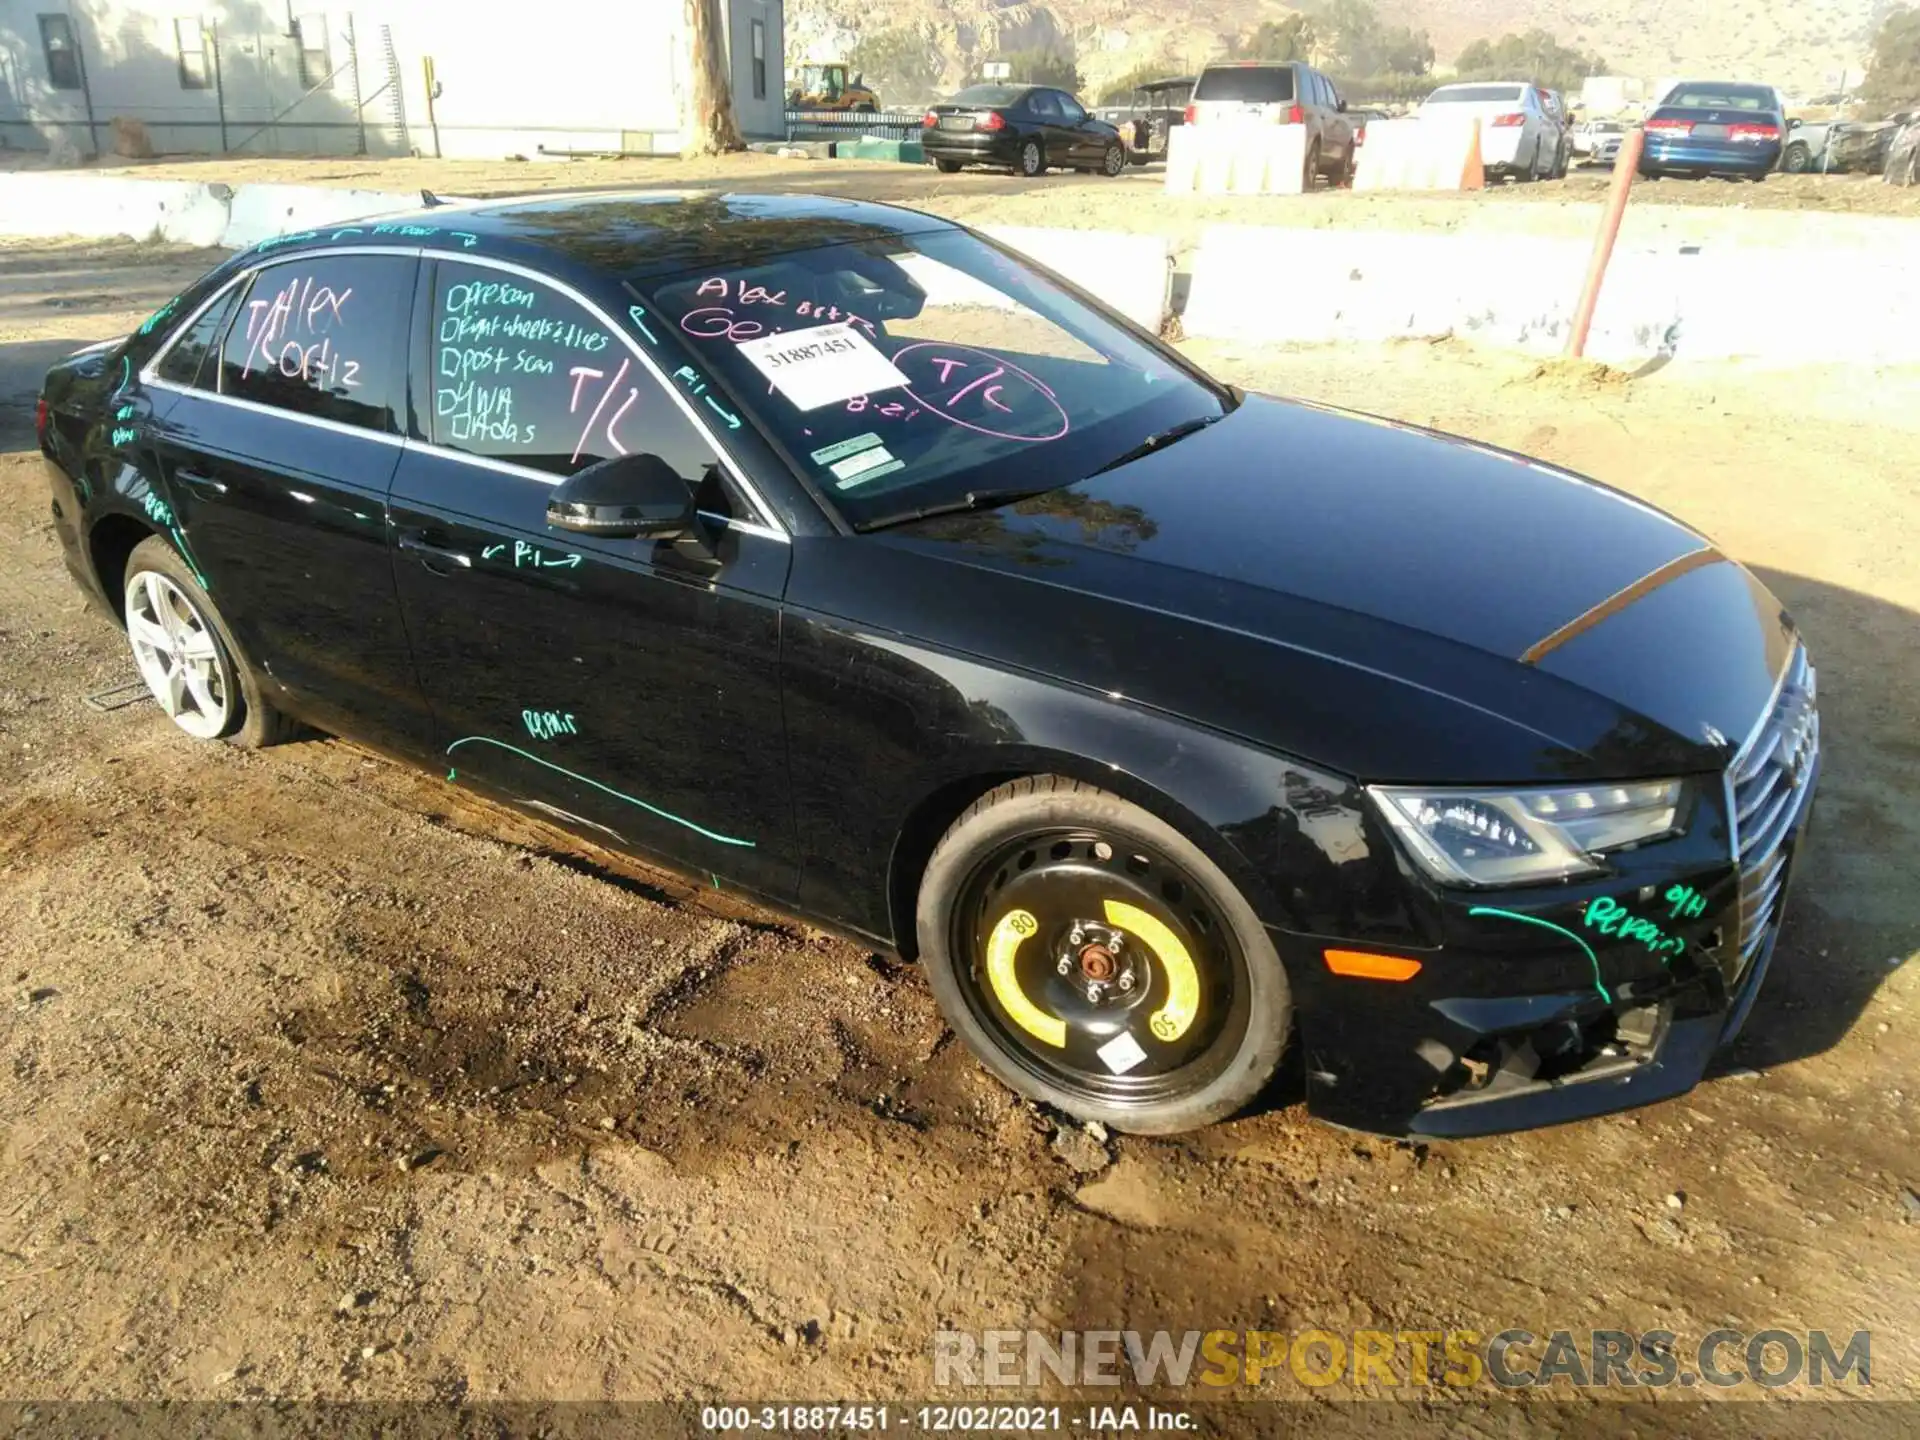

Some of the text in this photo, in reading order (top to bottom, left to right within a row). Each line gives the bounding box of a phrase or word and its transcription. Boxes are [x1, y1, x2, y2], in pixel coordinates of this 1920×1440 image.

[696, 277, 786, 306] Alex
[269, 277, 353, 341] Alex
[765, 338, 857, 368] 31887451
[1011, 914, 1034, 934] 80
